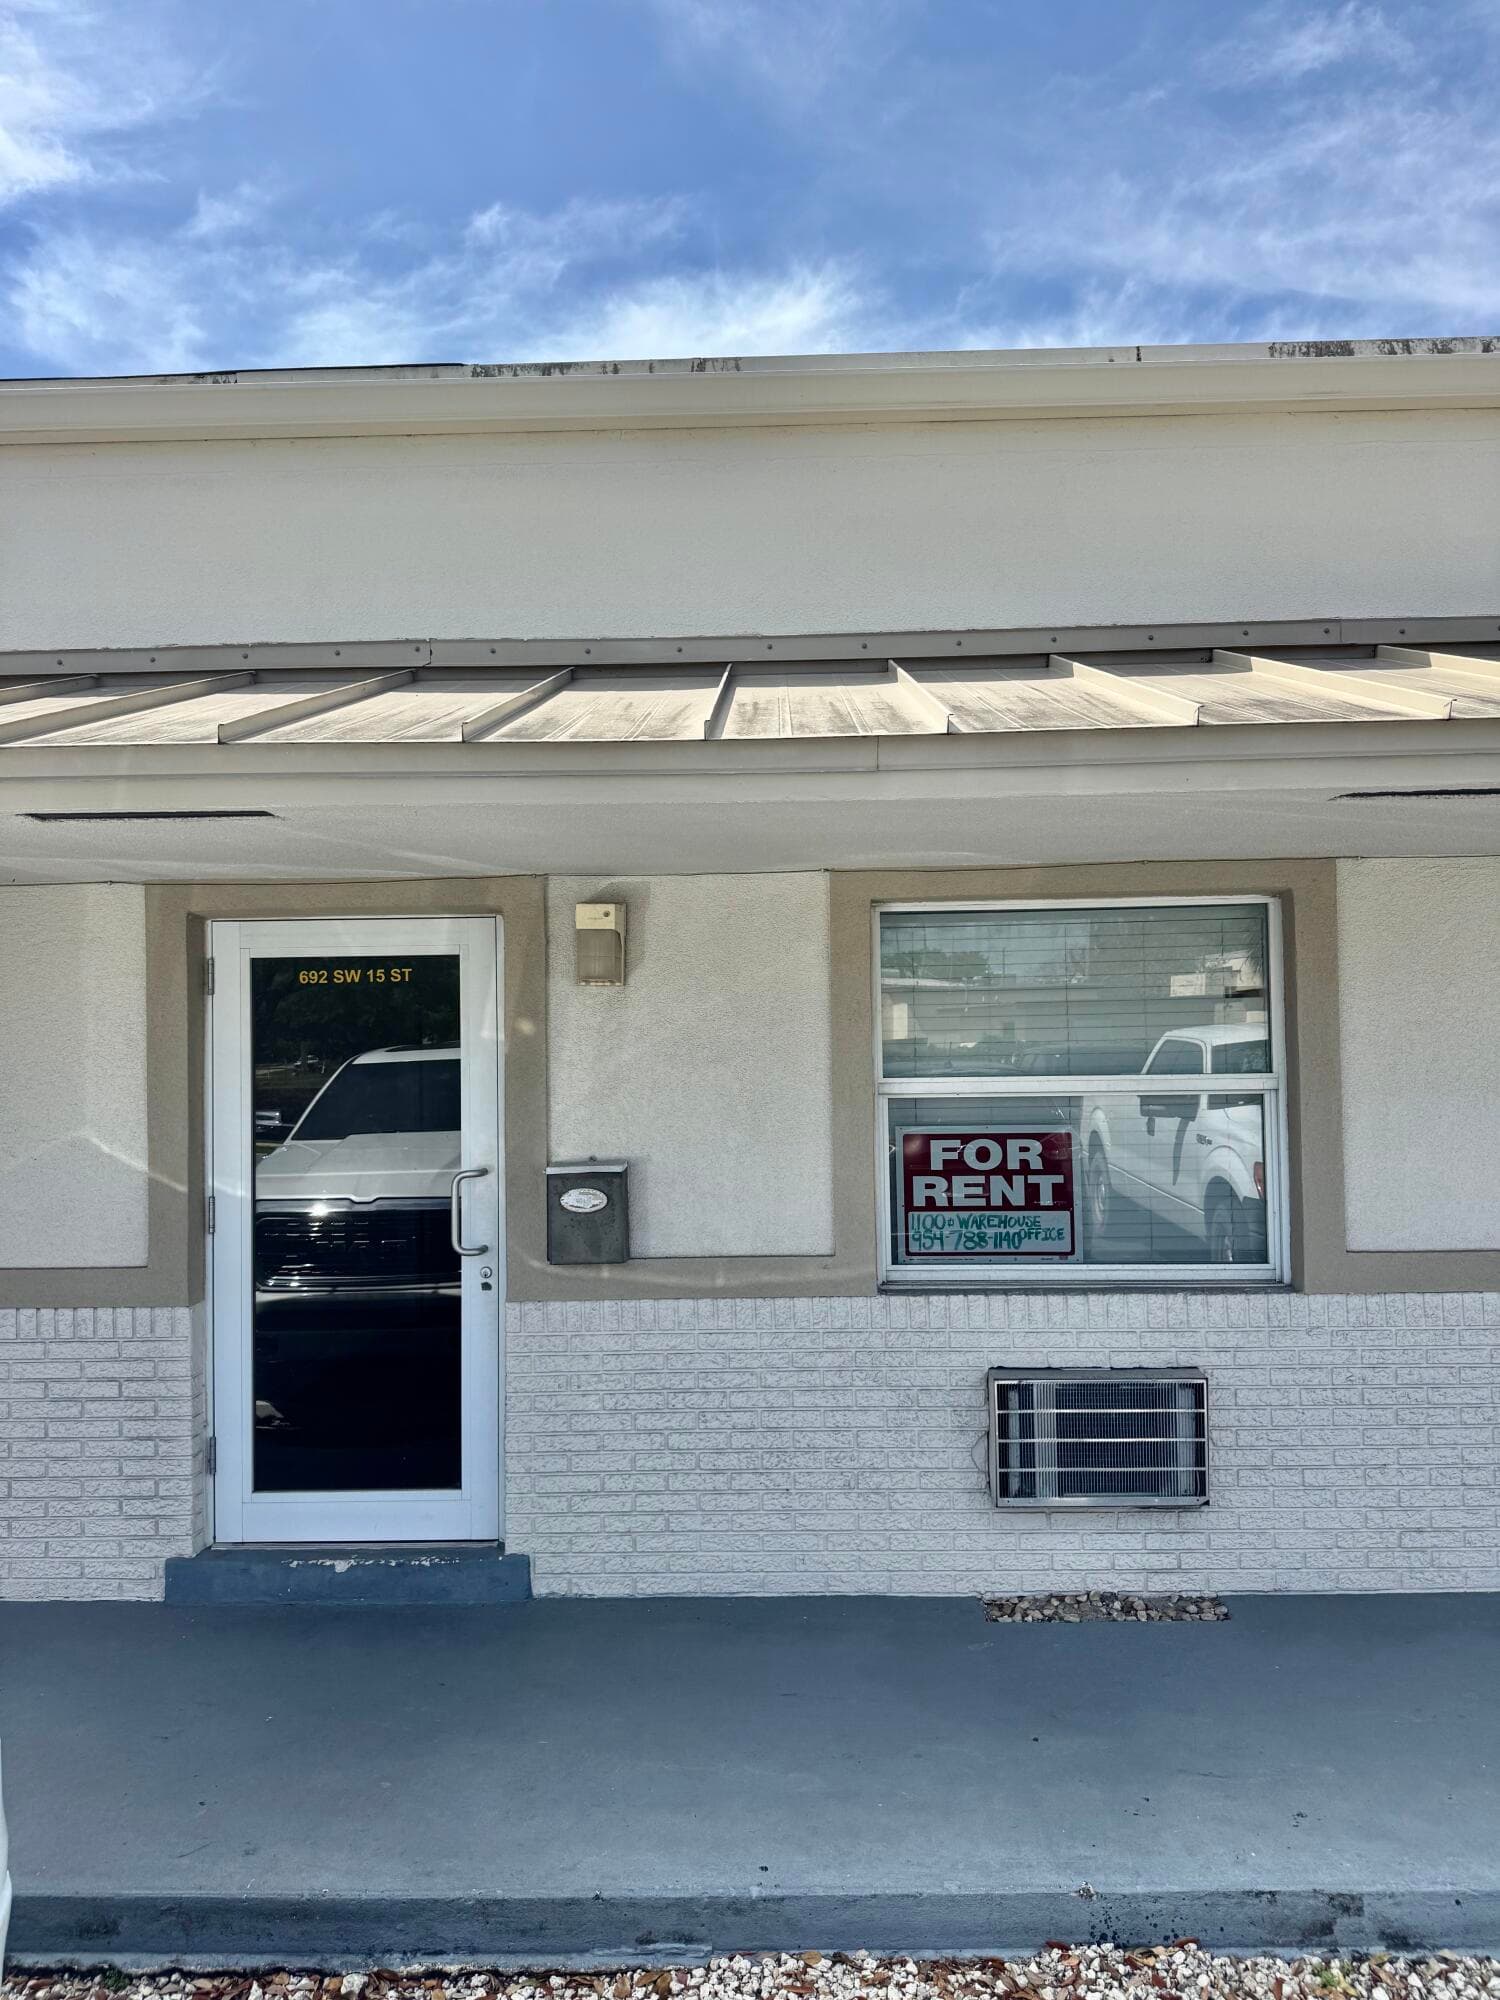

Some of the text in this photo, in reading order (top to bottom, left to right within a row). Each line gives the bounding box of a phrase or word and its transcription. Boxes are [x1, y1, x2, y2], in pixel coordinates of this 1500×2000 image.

[299, 968, 412, 984] 692 SW 15 ST
[930, 1138, 1044, 1171] FOR
[912, 1175, 1065, 1207] RENT
[956, 1213, 1041, 1230] WAREHOUSE
[1020, 1227, 1065, 1241] OFFICE
